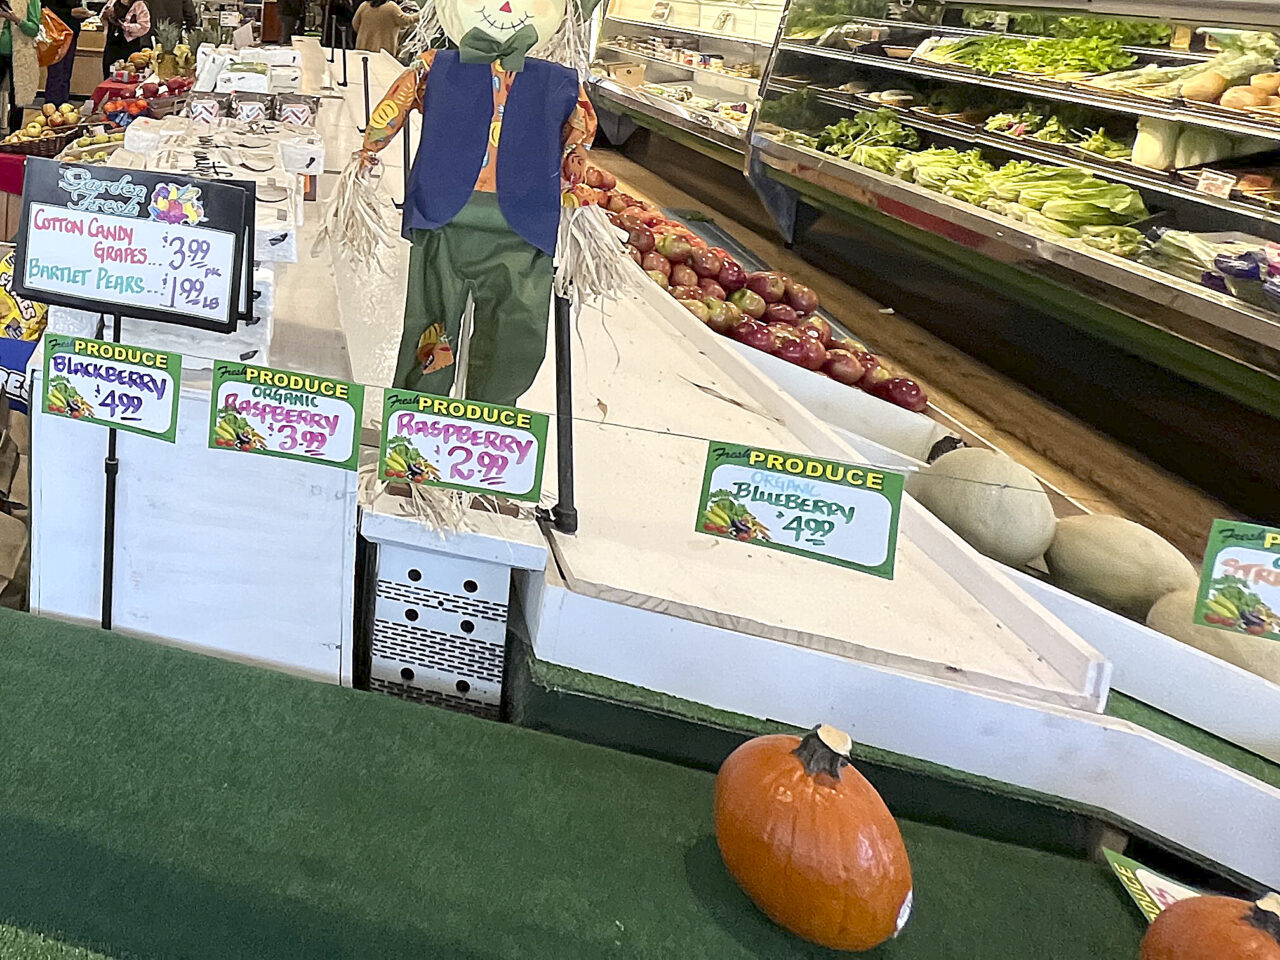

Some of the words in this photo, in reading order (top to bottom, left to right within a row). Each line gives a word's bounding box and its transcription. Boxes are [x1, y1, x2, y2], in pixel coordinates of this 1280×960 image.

[58, 167, 149, 203] Garden
[67, 190, 141, 217] Fresh
[33, 208, 85, 237] COTTON
[87, 216, 135, 247] CANDY
[28, 257, 92, 287] BARTLET
[202, 296, 220, 309] LB
[74, 340, 168, 369] PRODUCE
[50, 355, 167, 401] BLACKBERRY
[245, 367, 350, 399] PRODUCE
[251, 386, 320, 408] ORGANIC
[224, 393, 340, 437] RASPBERRY
[387, 394, 420, 408] Fresh
[418, 396, 532, 429] PRODUCE
[396, 412, 534, 465] RASPBERRY
[713, 447, 751, 461] Fresh
[749, 450, 884, 490] PRODUCE
[730, 482, 856, 525] BLUEBERRY
